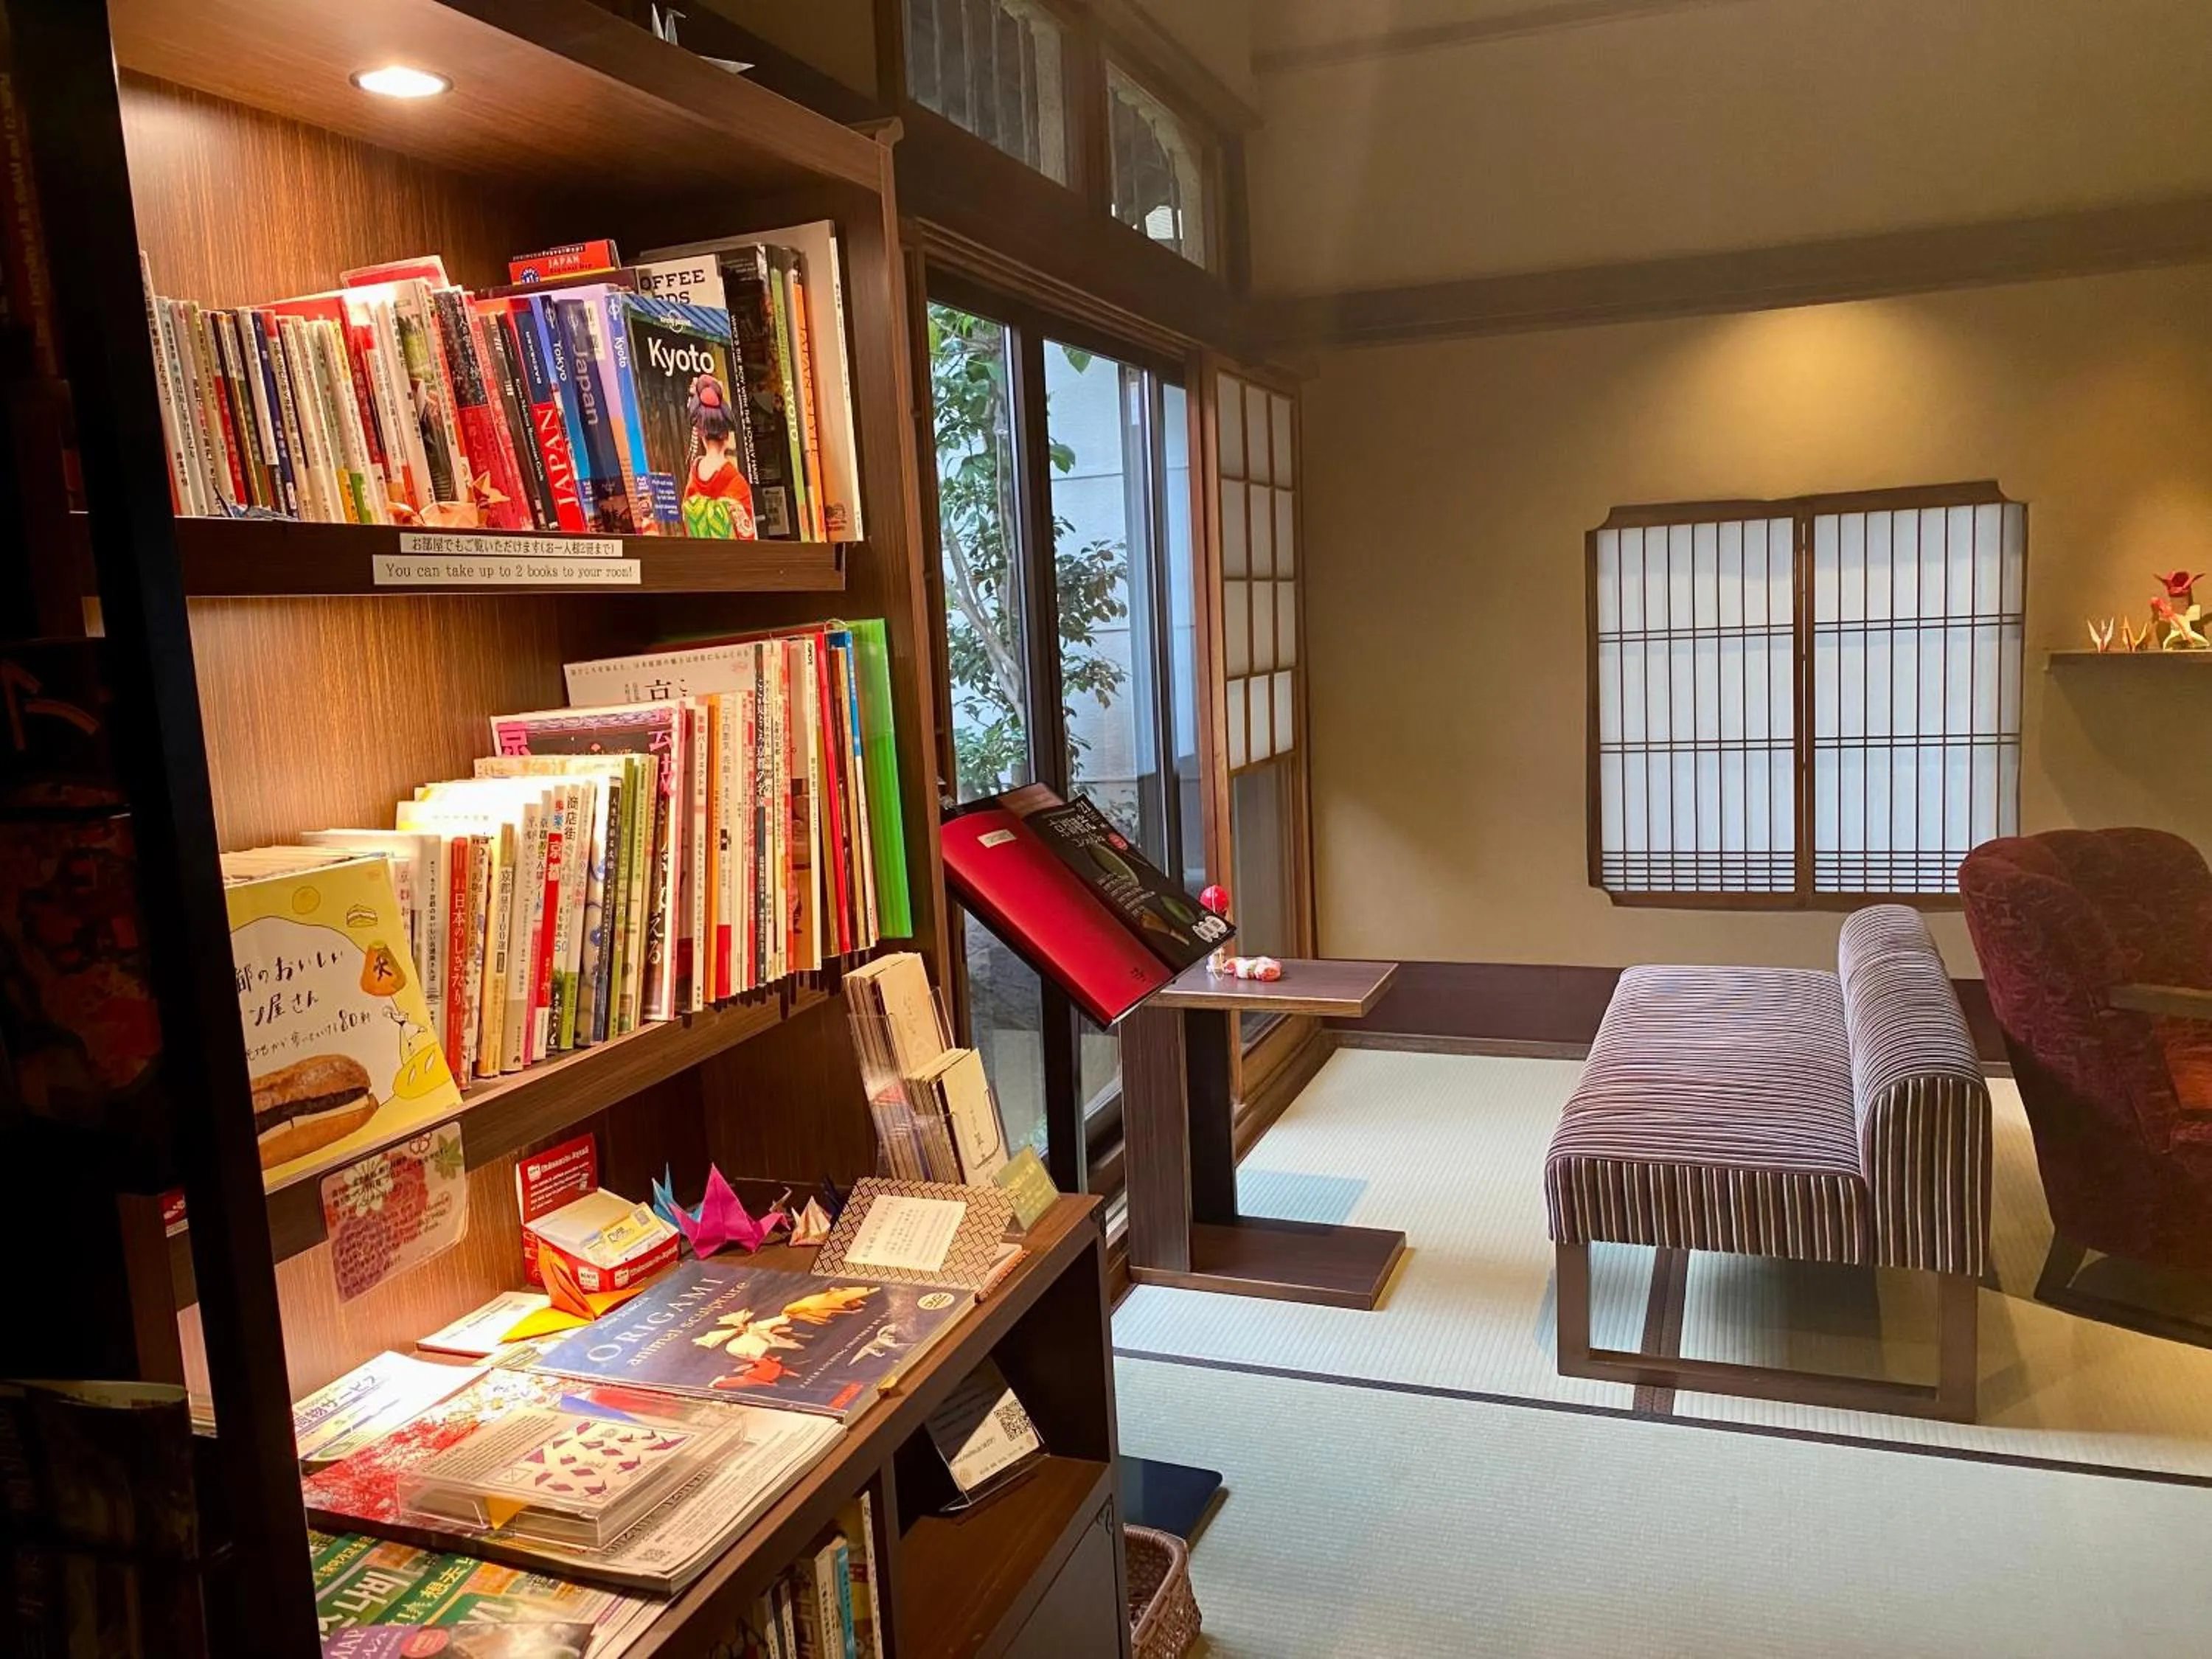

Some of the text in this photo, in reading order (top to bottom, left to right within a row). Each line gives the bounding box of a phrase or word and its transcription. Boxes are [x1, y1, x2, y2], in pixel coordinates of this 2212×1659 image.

[548, 255, 579, 268] JAPAN
[640, 268, 706, 291] OFFEE
[552, 341, 567, 381] Tokyo
[613, 336, 627, 369] Kyoto
[647, 336, 715, 378] Kyoto
[572, 347, 599, 425] Japan
[783, 379, 799, 442] KYOTO
[536, 408, 580, 507] JAPAN
[386, 563, 411, 577] You
[417, 566, 440, 577] can
[446, 564, 474, 577] take
[479, 567, 495, 580] up
[499, 566, 511, 577] to
[515, 564, 523, 577] 2
[527, 565, 557, 577] books
[563, 566, 574, 577] to
[578, 568, 602, 580] your
[234, 947, 344, 995] 都のおいしい
[451, 893, 467, 1006] 日本のしきたり
[248, 992, 320, 1026] ン屋さん
[585, 1276, 724, 1363] ORIGAMI
[628, 1281, 751, 1367] animal sculpture
